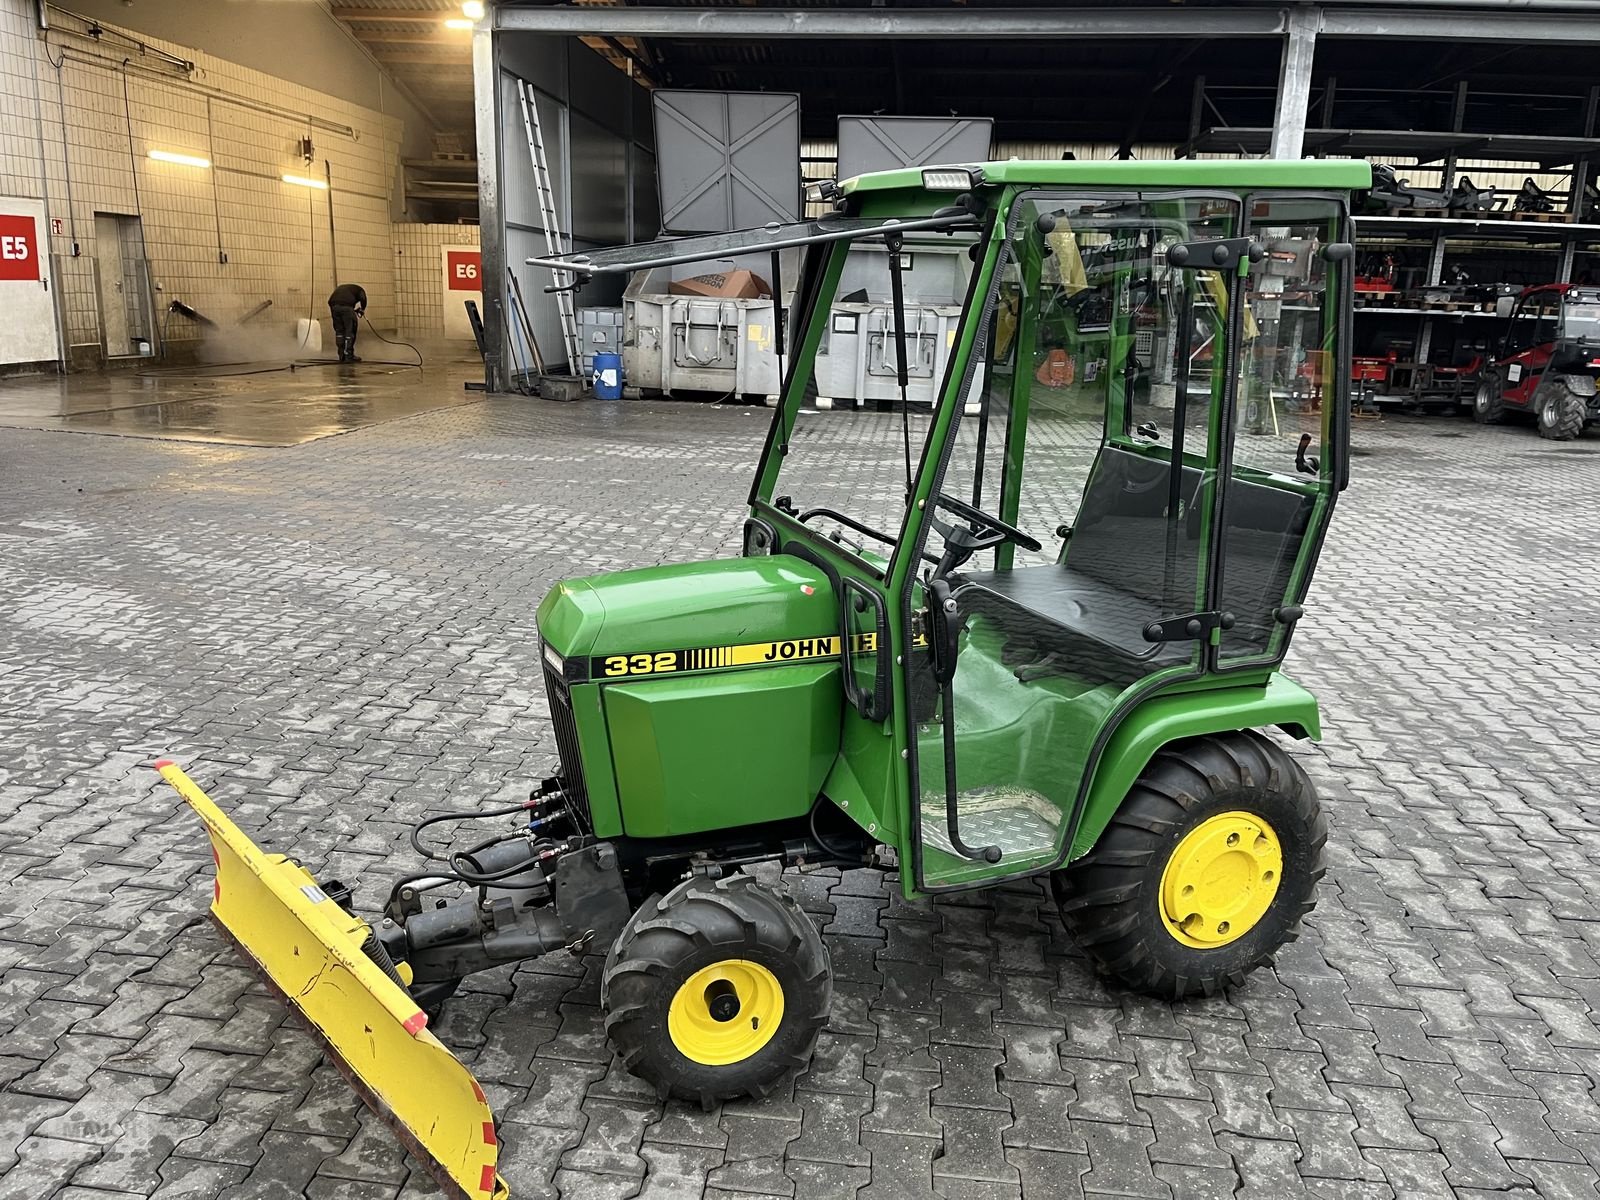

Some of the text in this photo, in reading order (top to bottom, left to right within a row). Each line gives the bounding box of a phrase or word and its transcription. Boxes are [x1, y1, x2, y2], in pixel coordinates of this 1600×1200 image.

[1, 236, 28, 260] E5
[456, 263, 477, 279] E6
[604, 653, 677, 676] 332
[765, 638, 832, 660] JOHN
